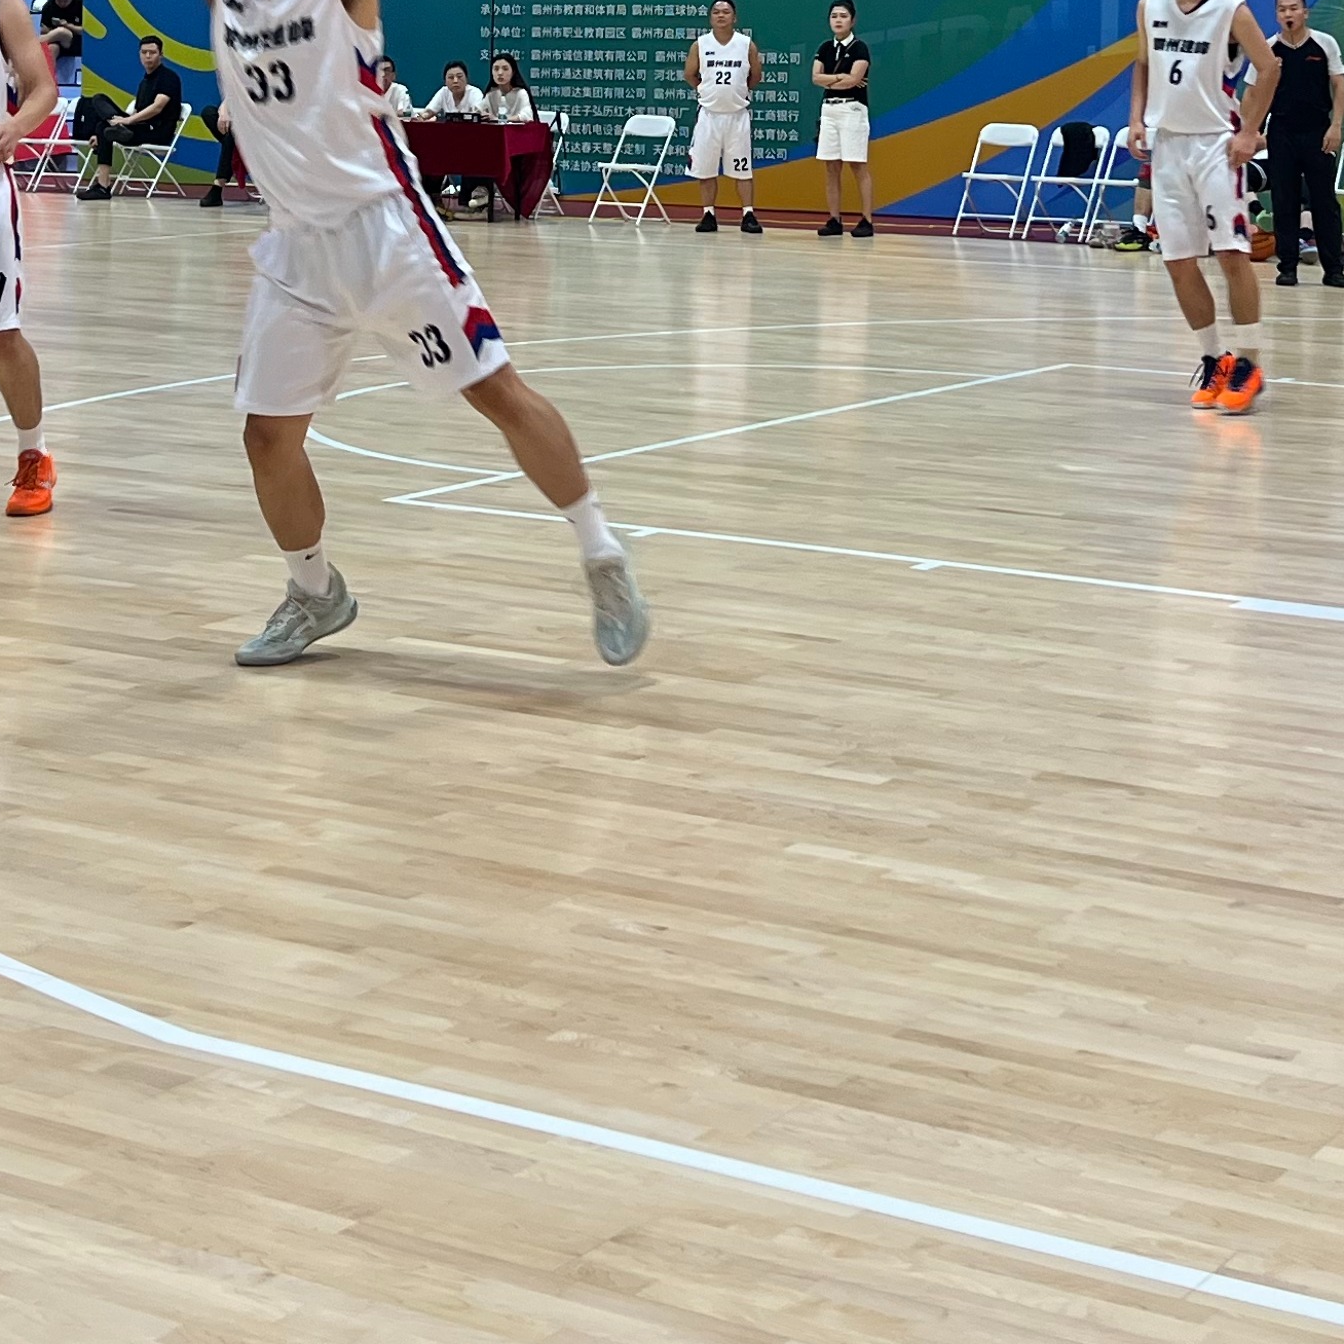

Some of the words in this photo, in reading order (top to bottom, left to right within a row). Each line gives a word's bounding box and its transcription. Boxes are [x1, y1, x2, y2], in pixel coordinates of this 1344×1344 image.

[244, 59, 296, 105] 33
[715, 71, 732, 85] 22
[1169, 59, 1183, 85] 6
[733, 157, 749, 172] 22
[408, 323, 453, 369] 33
